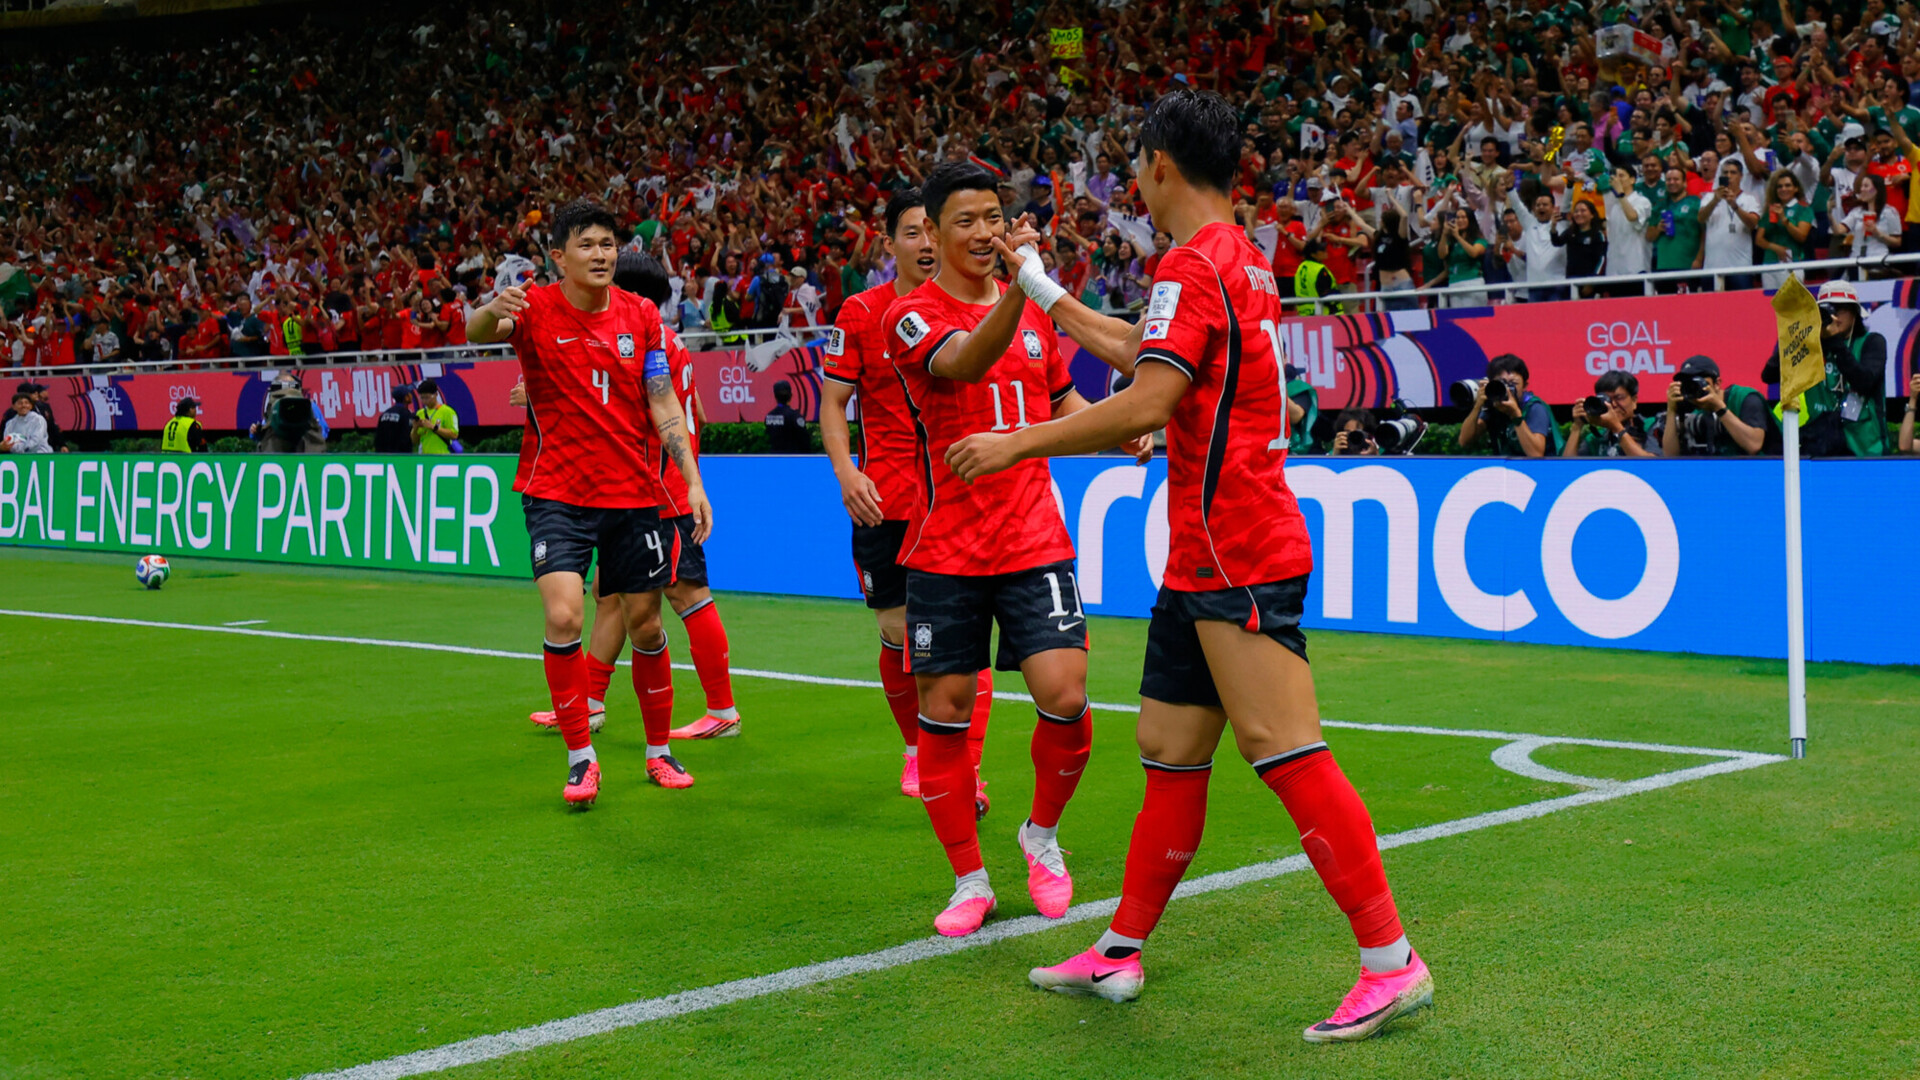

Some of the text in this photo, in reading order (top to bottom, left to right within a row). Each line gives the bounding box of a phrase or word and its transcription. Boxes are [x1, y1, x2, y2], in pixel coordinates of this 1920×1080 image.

[1586, 320, 1672, 348] GOAL
[719, 366, 753, 385] GOL
[1585, 349, 1676, 376] GOAL
[168, 385, 201, 401] GOAL
[592, 368, 610, 406] 4
[719, 386, 756, 404] GOL
[988, 379, 1030, 431] 11
[75, 460, 247, 551] ENERGY
[256, 462, 500, 567] PARTNER
[644, 529, 664, 565] 4
[1050, 464, 1681, 640] rmco
[1042, 571, 1085, 620] 11
